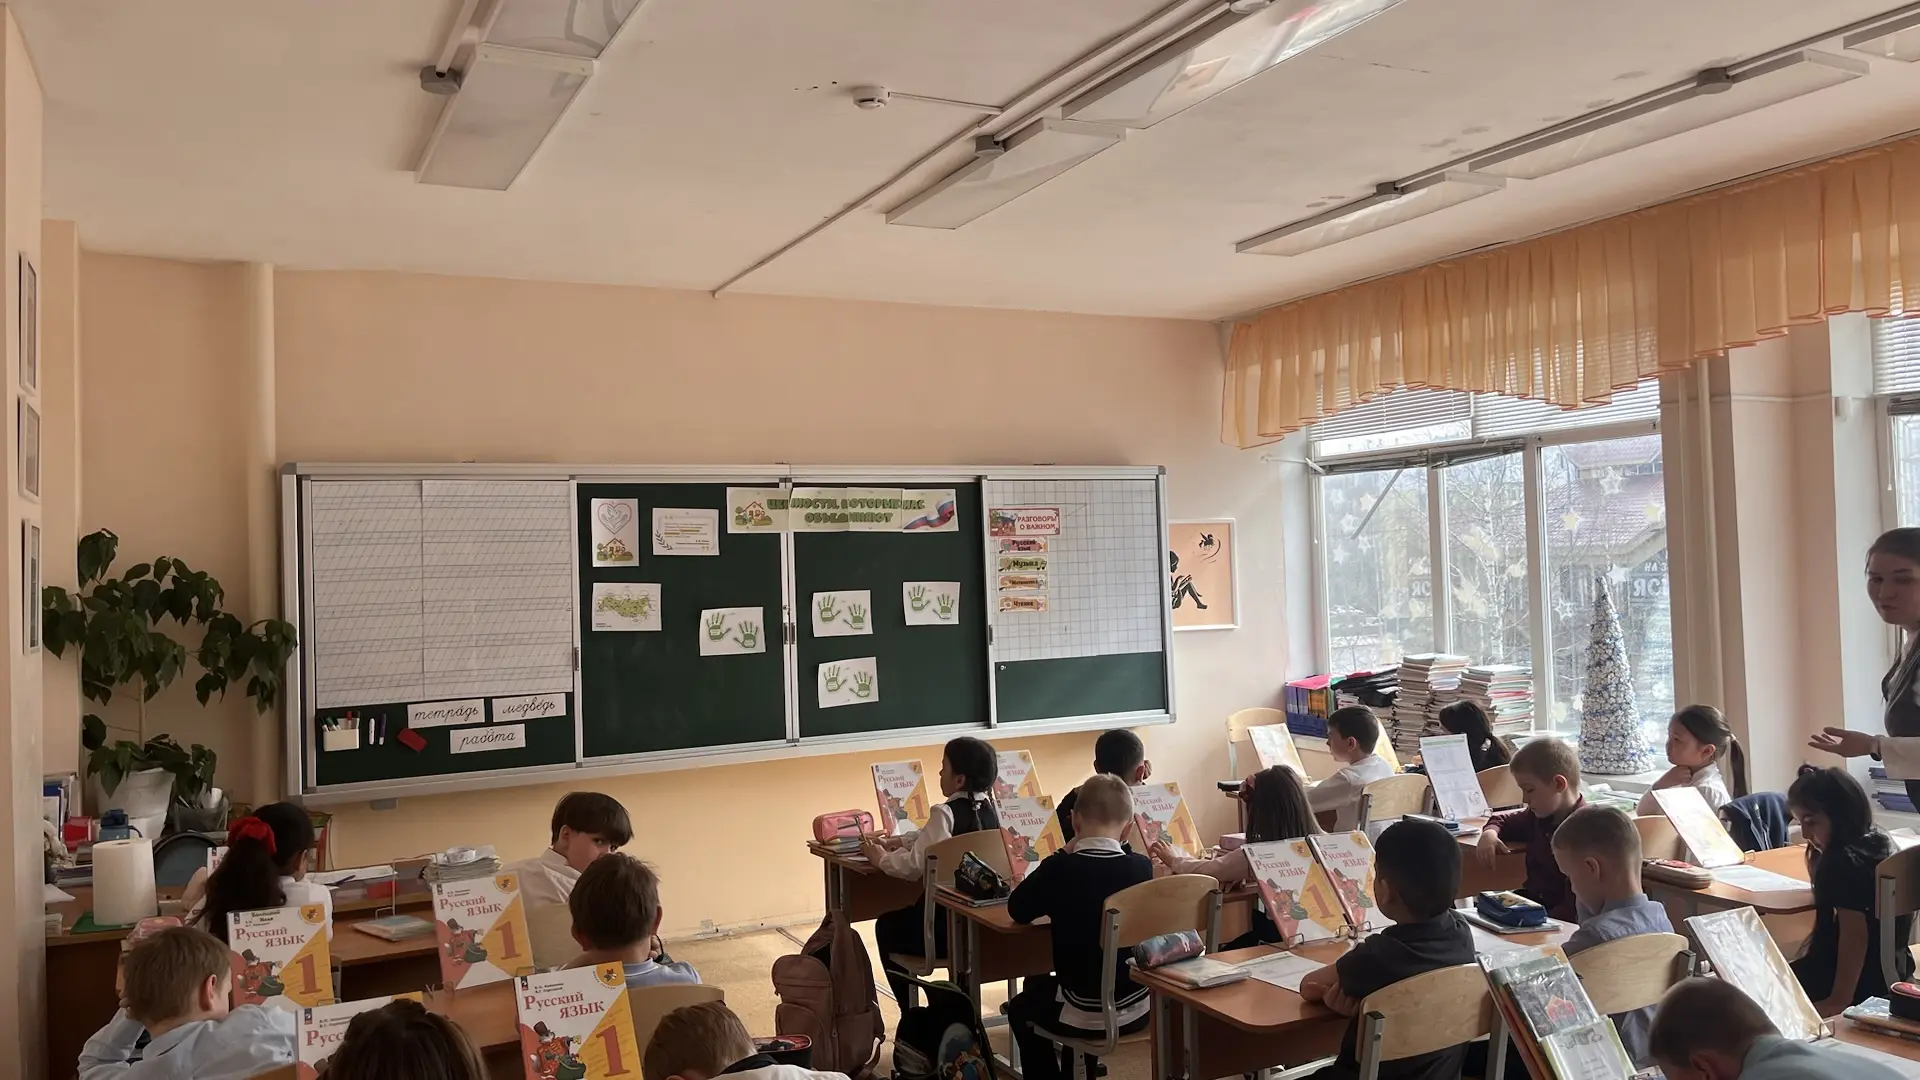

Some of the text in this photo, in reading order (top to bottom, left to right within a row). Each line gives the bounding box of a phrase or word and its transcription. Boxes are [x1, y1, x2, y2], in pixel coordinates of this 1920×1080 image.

[1012, 560, 1038, 568] Музыка
[911, 793, 928, 820] 1
[1001, 810, 1033, 820] Русский
[1172, 815, 1193, 845] 1
[1254, 860, 1292, 872] Русский
[440, 896, 486, 911] Русский
[1306, 883, 1336, 919] 1
[235, 926, 288, 941] Русский
[495, 920, 521, 960] 1
[295, 953, 323, 995] 1
[524, 991, 584, 1012] Русский
[305, 1030, 344, 1047] Русс
[595, 1024, 631, 1078] 1
